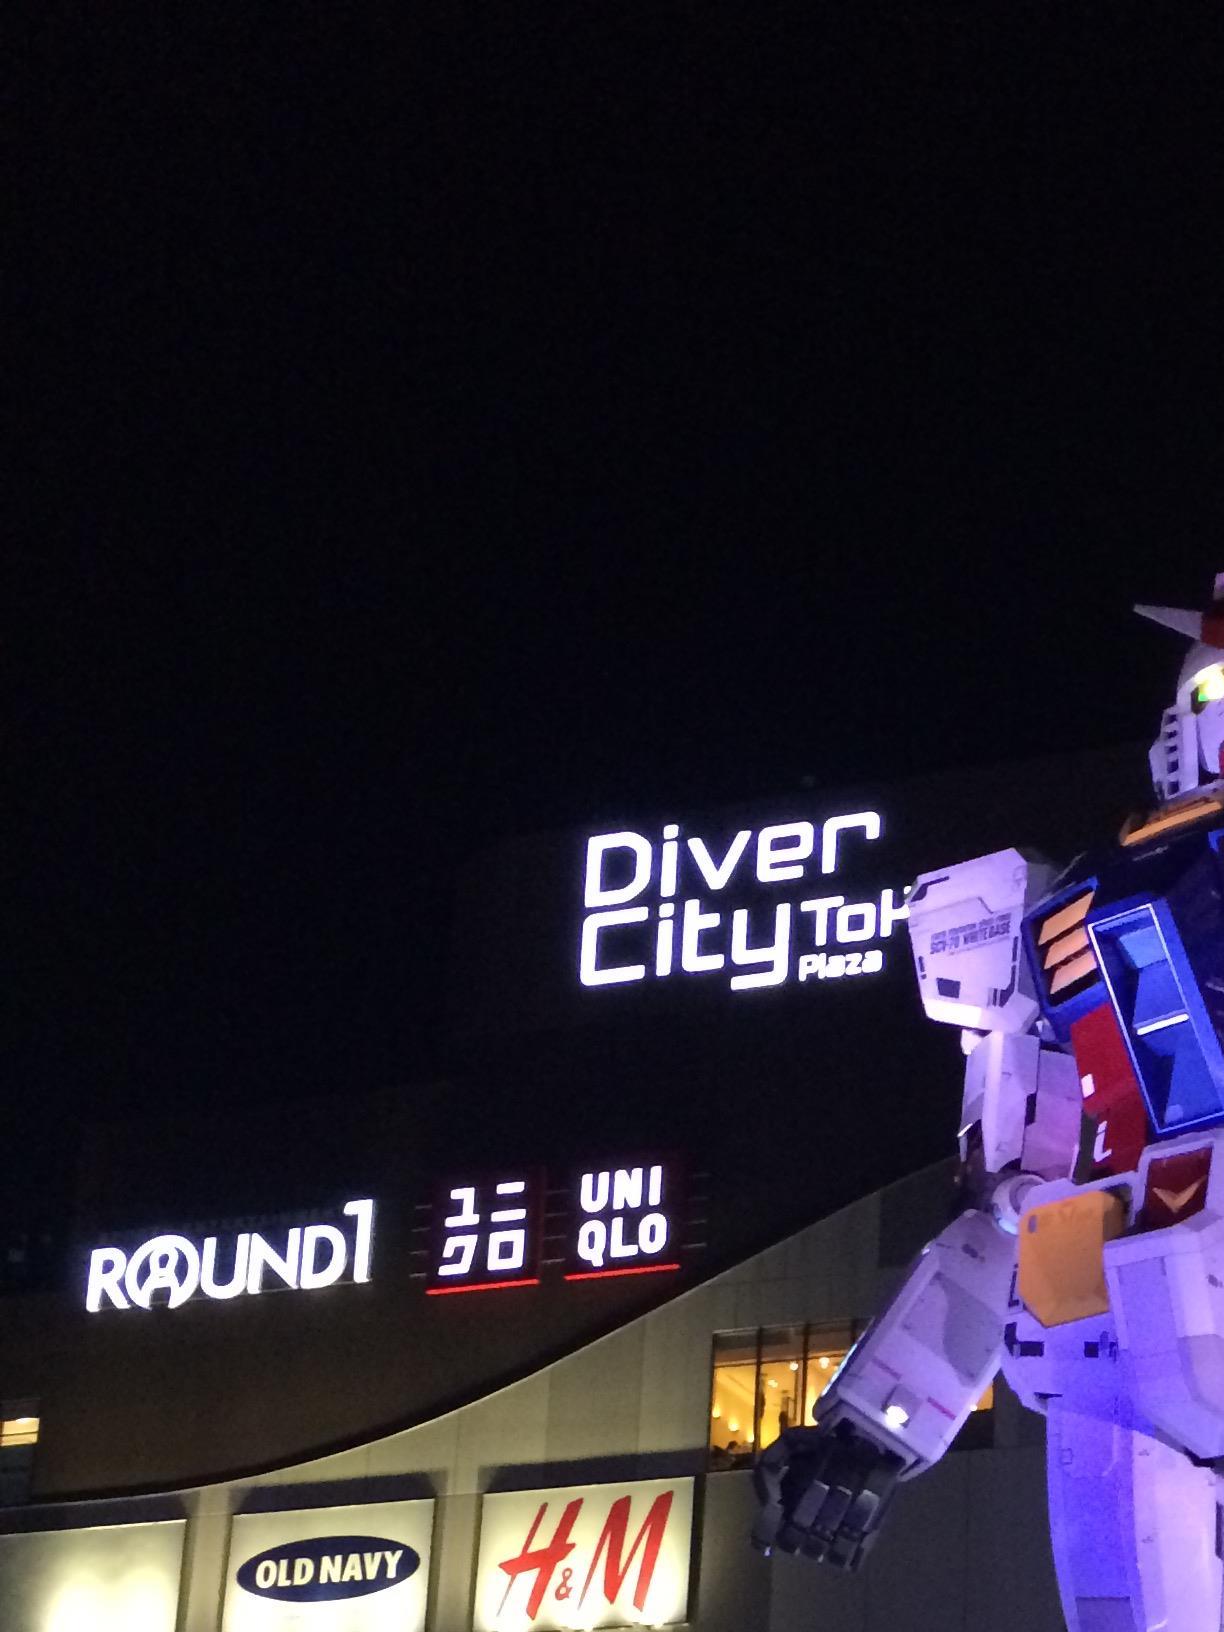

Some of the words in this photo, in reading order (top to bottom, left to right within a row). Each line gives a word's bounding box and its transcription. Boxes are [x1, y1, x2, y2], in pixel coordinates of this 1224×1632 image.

[584, 811, 881, 908] Diver
[579, 898, 791, 991] City
[800, 886, 912, 947] Tok
[798, 949, 883, 982] Plaza
[580, 1165, 662, 1213] UNI
[577, 1212, 668, 1267] QLO
[255, 1557, 316, 1590] OLD
[319, 1549, 404, 1584] NAVY
[498, 1490, 674, 1620] H&M
